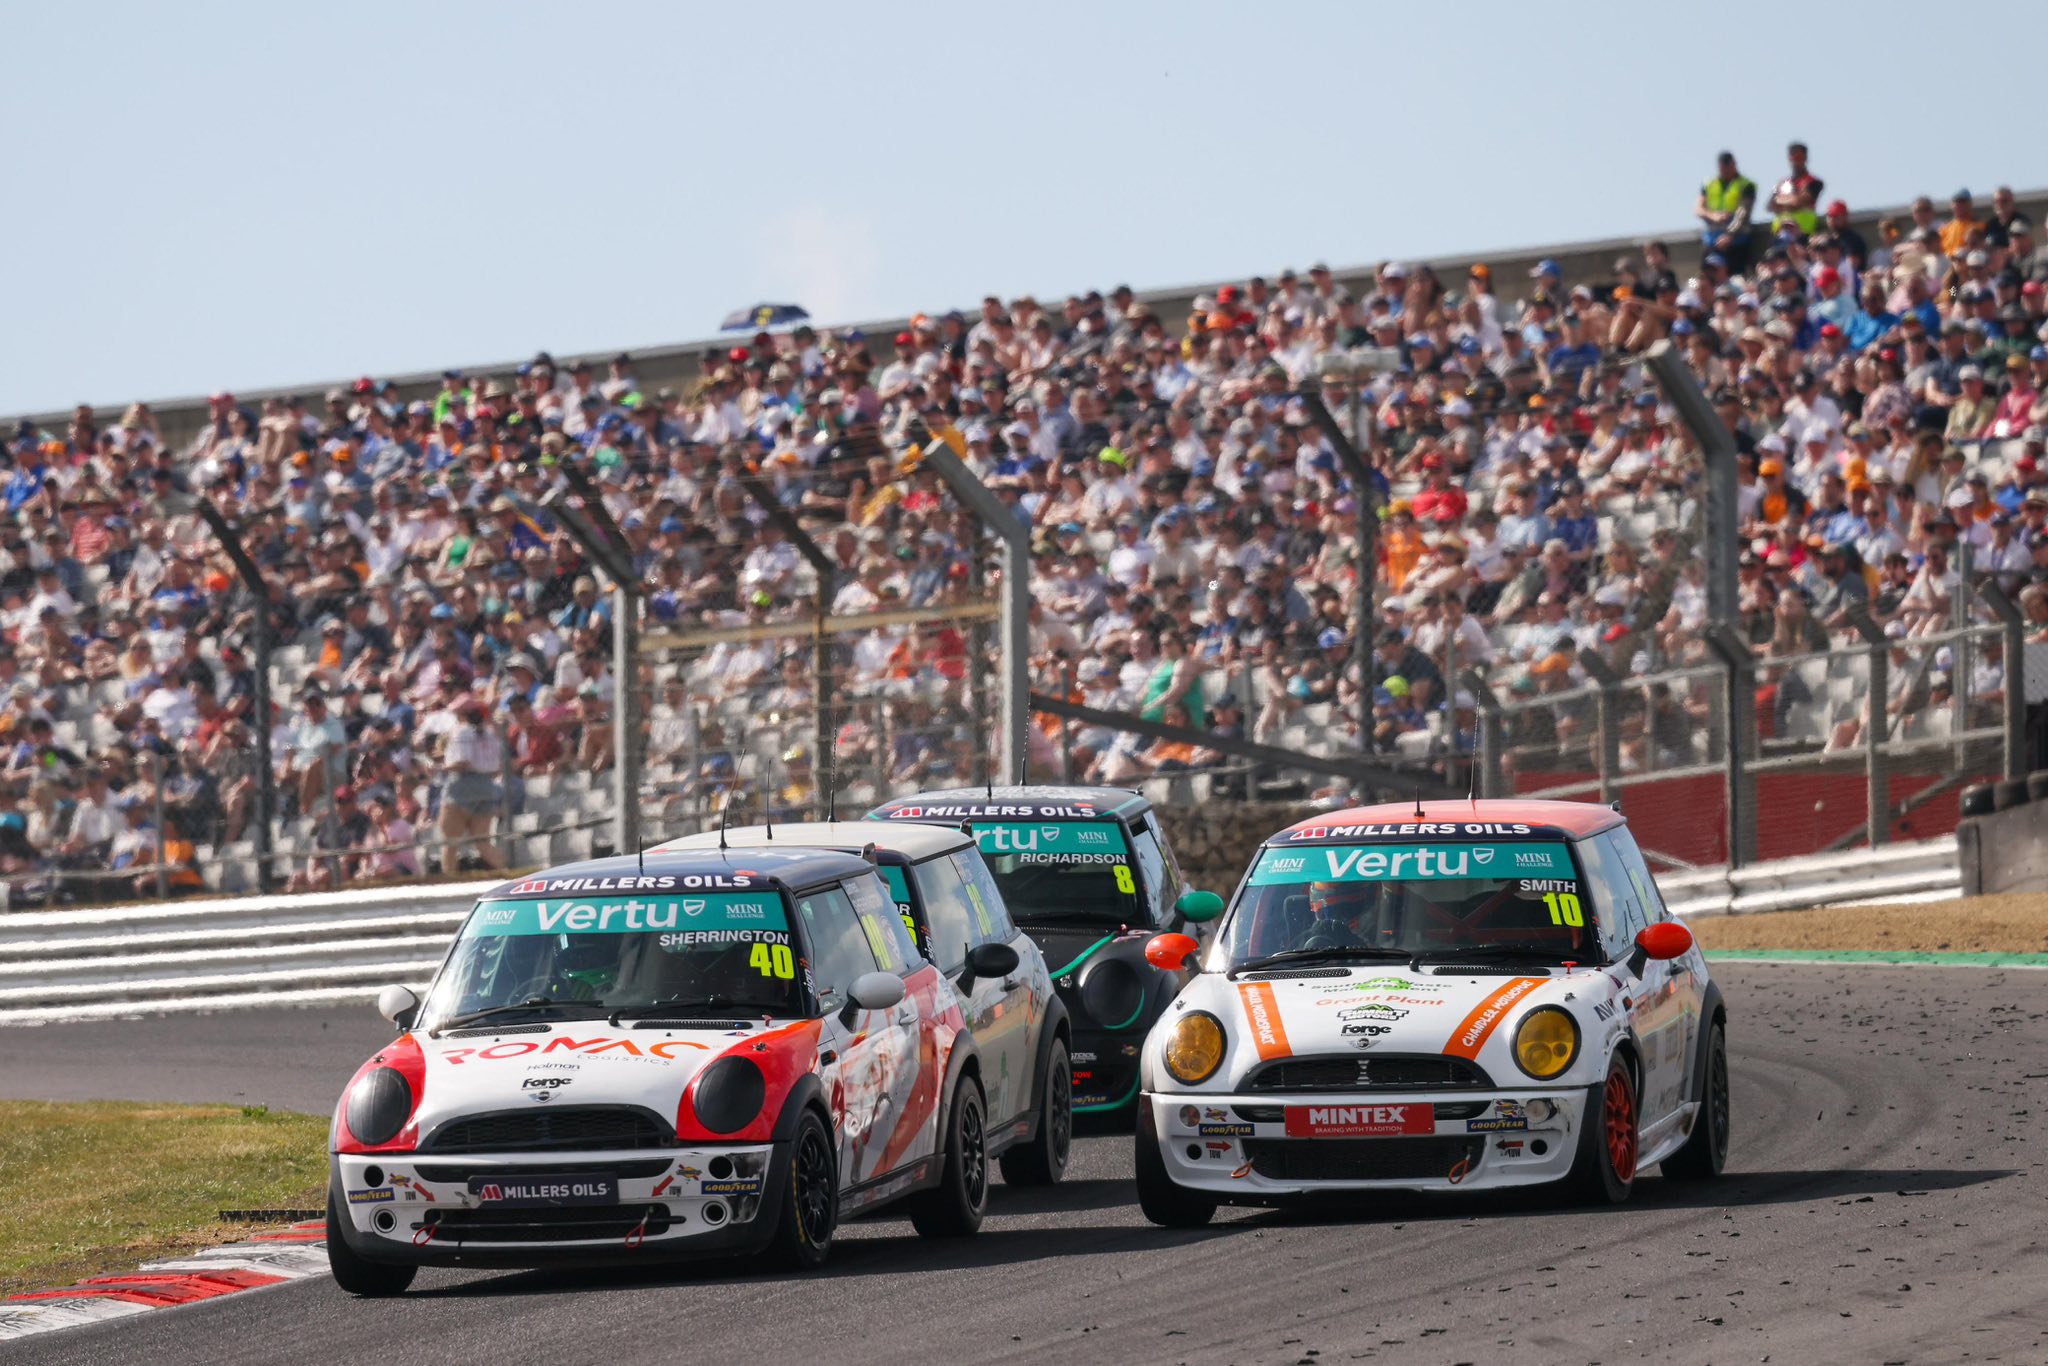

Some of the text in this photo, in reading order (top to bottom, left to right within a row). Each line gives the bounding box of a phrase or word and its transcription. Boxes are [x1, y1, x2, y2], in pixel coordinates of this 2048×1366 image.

[925, 806, 1096, 818] MILLERS OILS
[1077, 832, 1107, 840] MINI
[1330, 823, 1531, 837] MILLERS OILS
[976, 826, 1038, 850] rtu
[1020, 853, 1127, 864] RICHARDSON
[1272, 858, 1306, 868] MINI
[1325, 848, 1468, 878] Vertu
[1515, 853, 1552, 863] MINI
[549, 875, 751, 891] MILLERS OILS
[1113, 865, 1136, 894] 8
[1520, 879, 1576, 893] SMITH
[485, 910, 517, 920] MINI
[537, 899, 678, 931] Vertu
[726, 904, 763, 913] MINI
[1542, 892, 1584, 927] 10
[659, 930, 789, 947] SHERRINGTON
[750, 943, 794, 980] 40
[1315, 994, 1446, 1006] Grant Plant
[1341, 1024, 1392, 1037] Forge
[441, 1036, 711, 1066] ROMAC
[527, 1062, 581, 1071] Holman
[577, 1054, 671, 1067] LOGISTICS
[1073, 1071, 1093, 1080] TOW
[522, 1078, 573, 1090] Forge
[1309, 1106, 1405, 1125] MINTEX
[1366, 1125, 1402, 1133] TRADITION
[504, 1183, 607, 1199] MILLERS OILS
[704, 1182, 757, 1193] GOODYEAR
